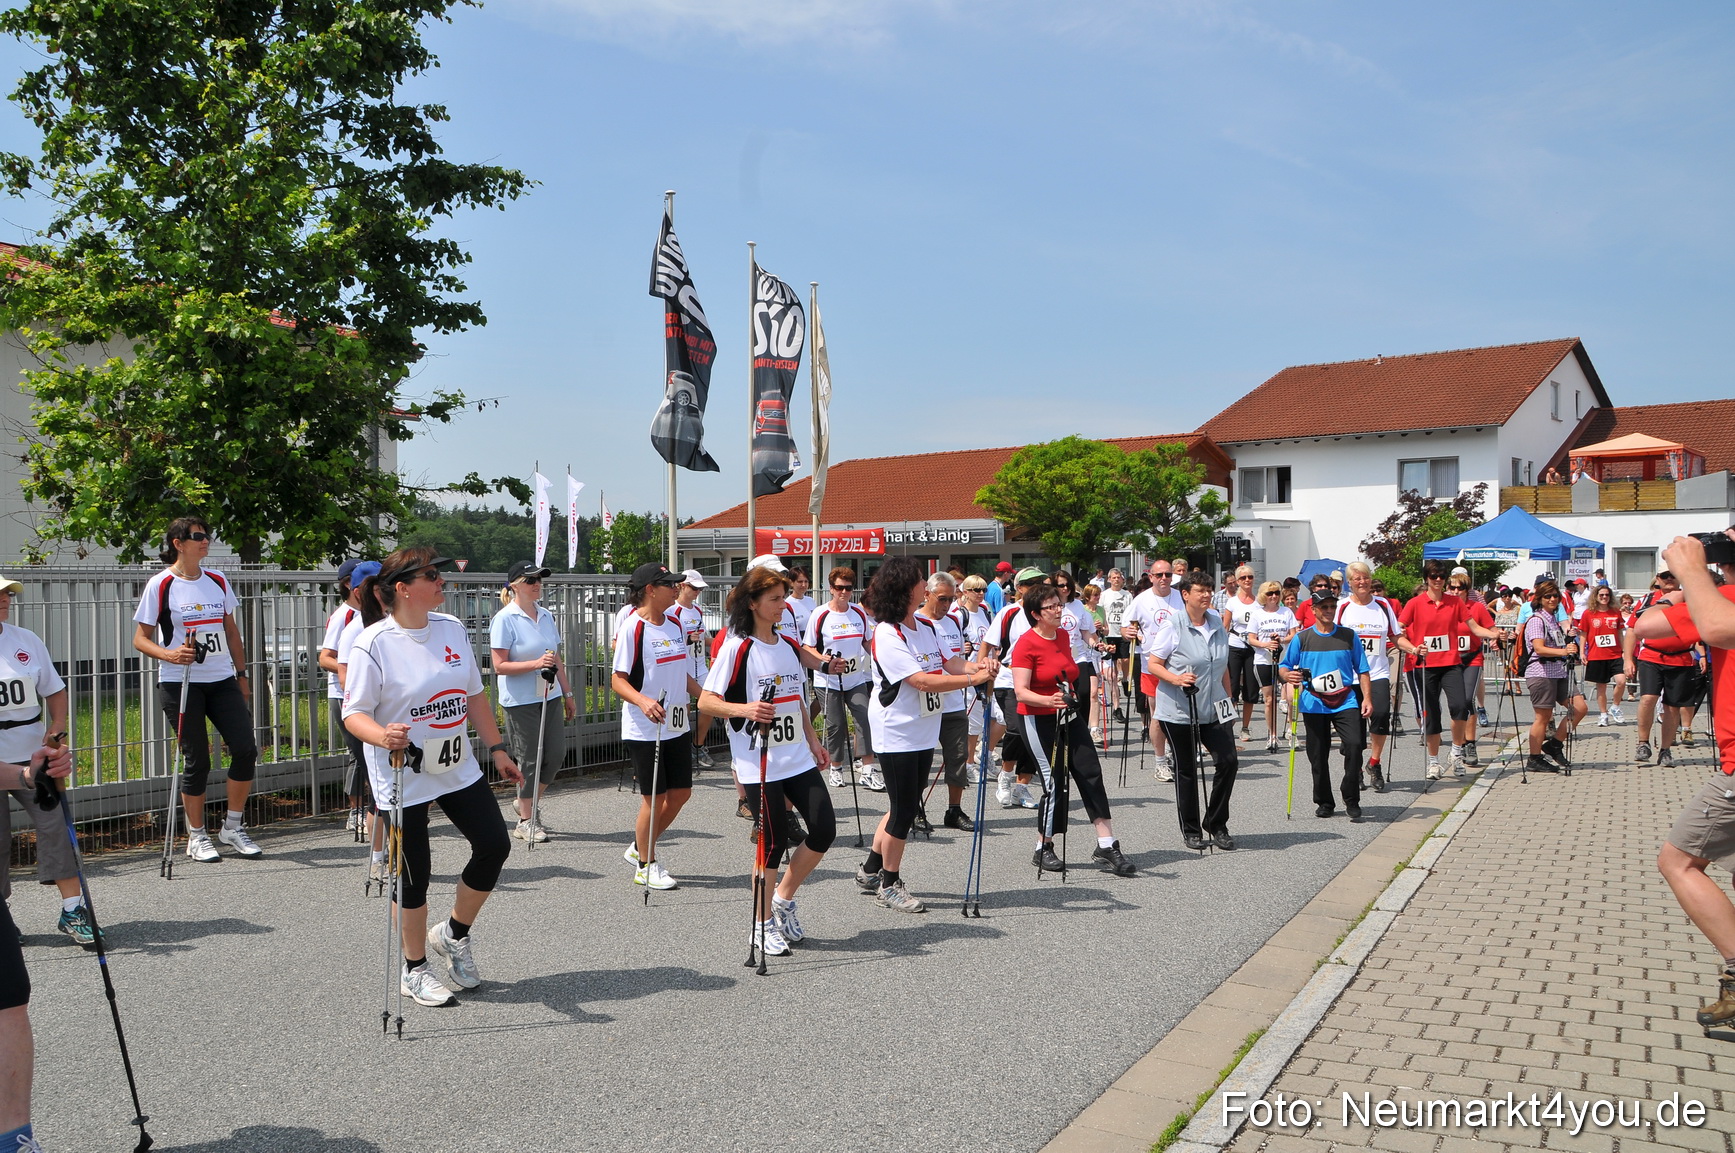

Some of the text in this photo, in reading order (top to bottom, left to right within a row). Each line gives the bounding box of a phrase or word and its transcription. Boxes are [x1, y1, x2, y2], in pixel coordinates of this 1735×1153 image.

[931, 528, 971, 544] Jänig
[1113, 613, 1121, 622] 75
[205, 633, 222, 653] 51
[1430, 636, 1442, 650] 41
[1458, 636, 1466, 649] 0
[1599, 635, 1611, 646] 25
[844, 658, 857, 674] 62
[1319, 673, 1337, 692] 73
[410, 696, 462, 718] GERHART
[925, 691, 941, 712] 63
[1219, 699, 1233, 719] 22
[411, 713, 436, 723] AUTOHAUS
[672, 706, 684, 729] 60
[772, 715, 795, 743] 56
[437, 735, 462, 768] 49
